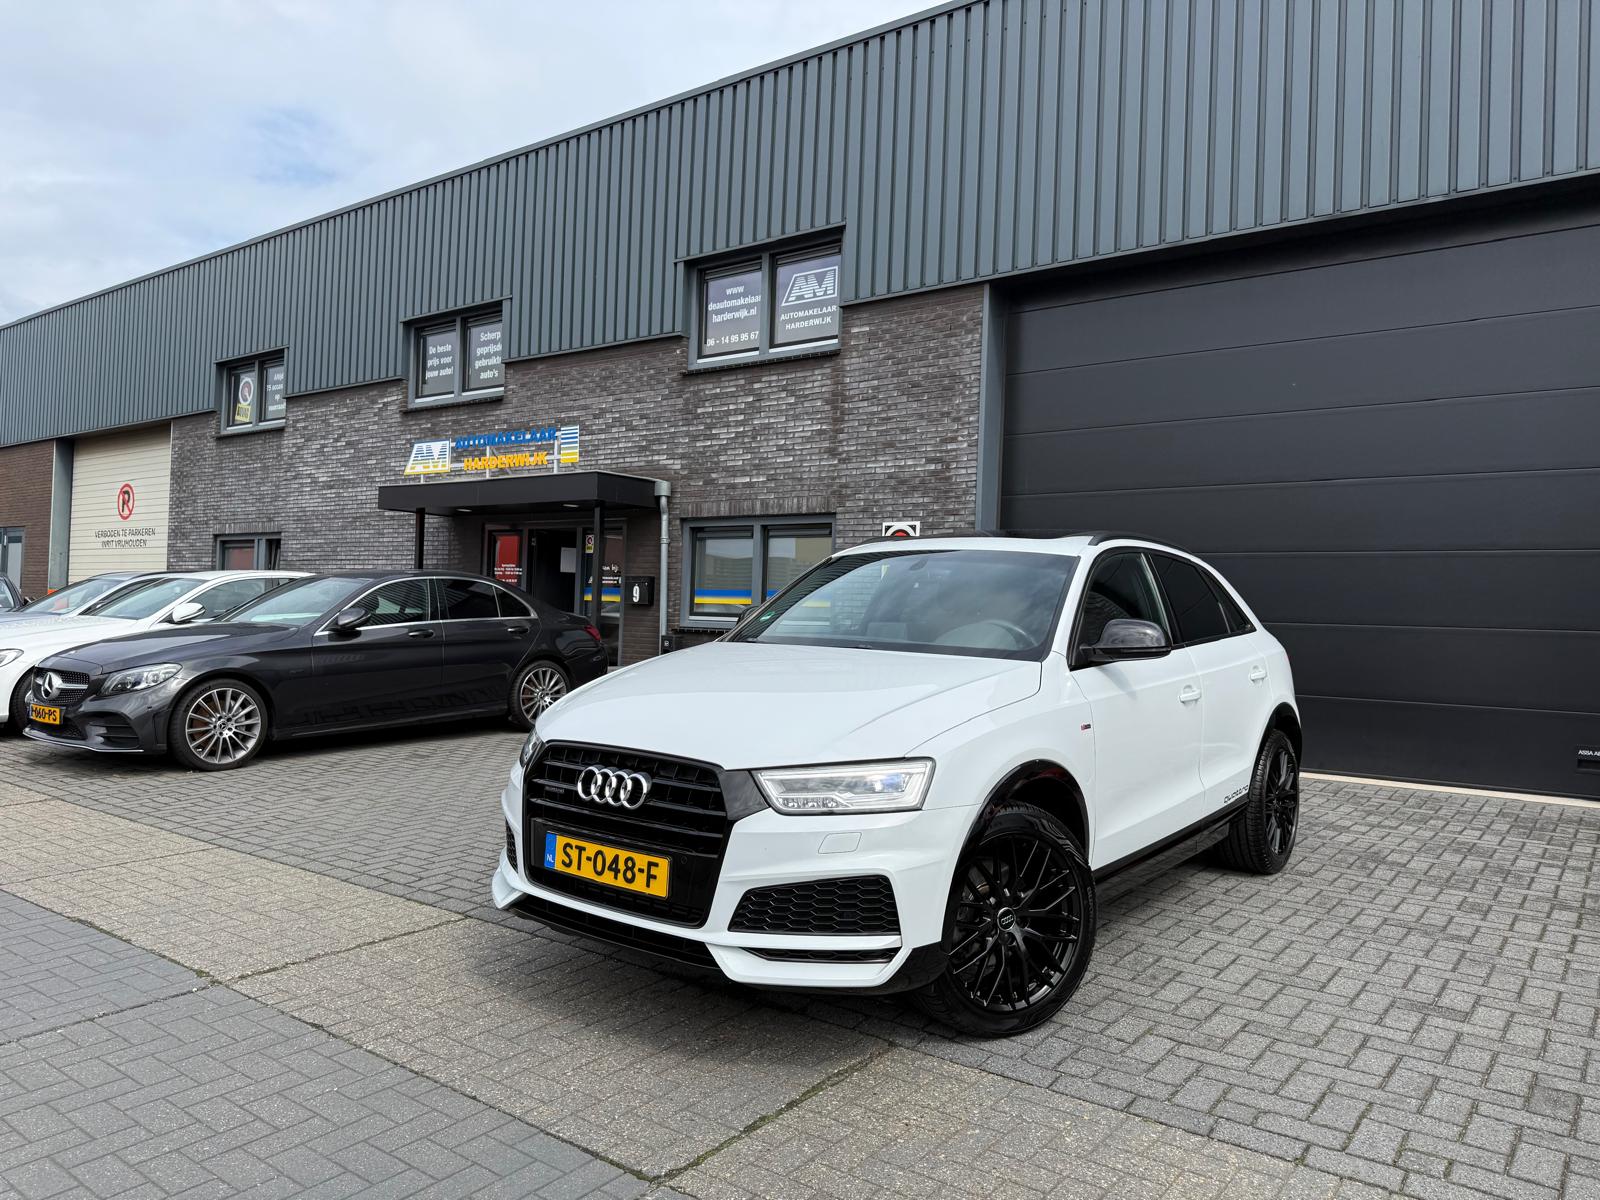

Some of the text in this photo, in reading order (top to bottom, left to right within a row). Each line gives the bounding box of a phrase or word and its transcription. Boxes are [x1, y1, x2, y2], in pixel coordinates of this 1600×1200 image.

[725, 285, 745, 296] www
[712, 306, 757, 323] harderwijk.nl
[780, 305, 837, 321] AUTOMAKELAAR
[785, 316, 832, 330] HARDERWIJK
[479, 331, 501, 341] Scherp
[721, 335, 729, 345] 14
[730, 334, 739, 343] 95
[740, 333, 749, 342] 95
[429, 344, 452, 355] De beste
[440, 356, 453, 364] voor
[439, 366, 454, 376] auto!
[479, 368, 499, 379] auto's
[455, 427, 557, 449] AUTOMAKELAAR
[463, 451, 548, 471] HARDERWIJK
[94, 527, 156, 538] VERBODEN TE PARKEREN
[632, 585, 640, 603] 9
[546, 853, 555, 863] NL
[561, 842, 659, 889] ST-048-F
